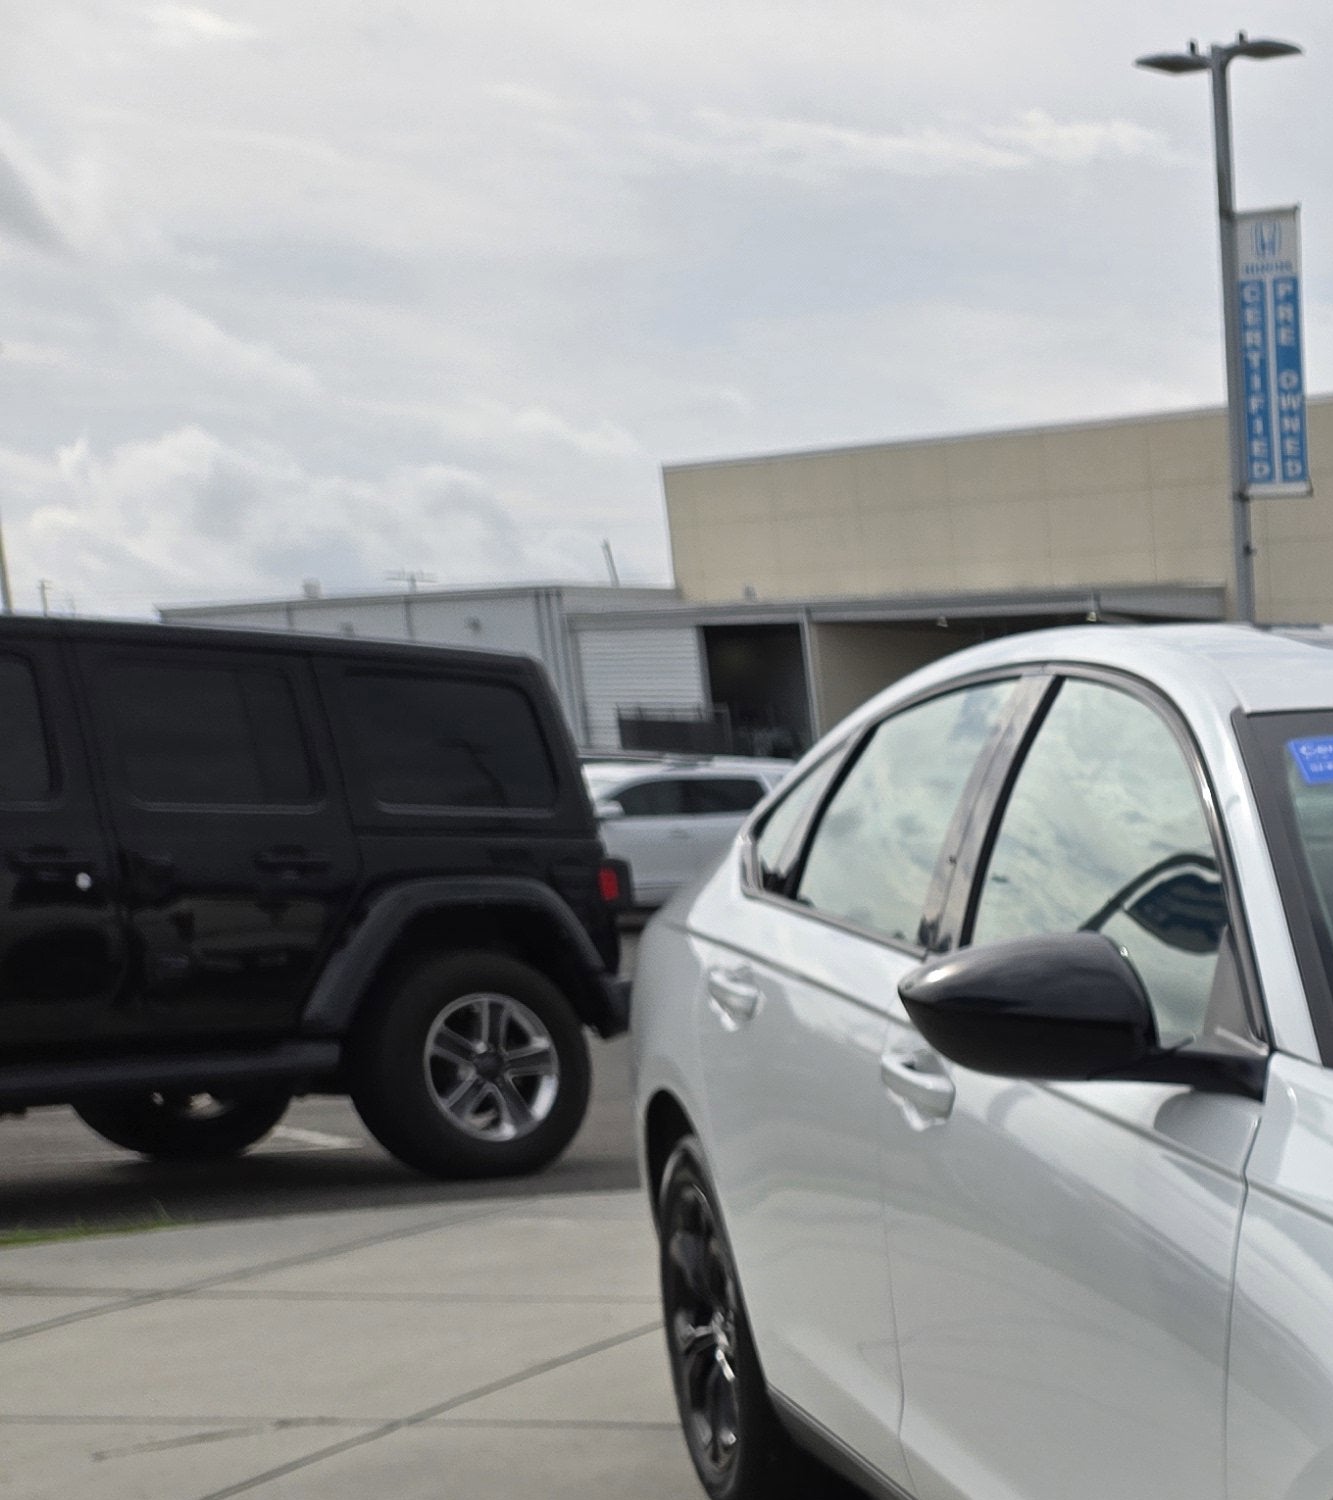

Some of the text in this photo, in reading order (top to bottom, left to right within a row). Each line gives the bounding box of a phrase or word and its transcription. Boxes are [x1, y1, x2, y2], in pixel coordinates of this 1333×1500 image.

[1243, 285, 1271, 480] CERTIFIED
[1278, 282, 1302, 479] PRE OWNED
